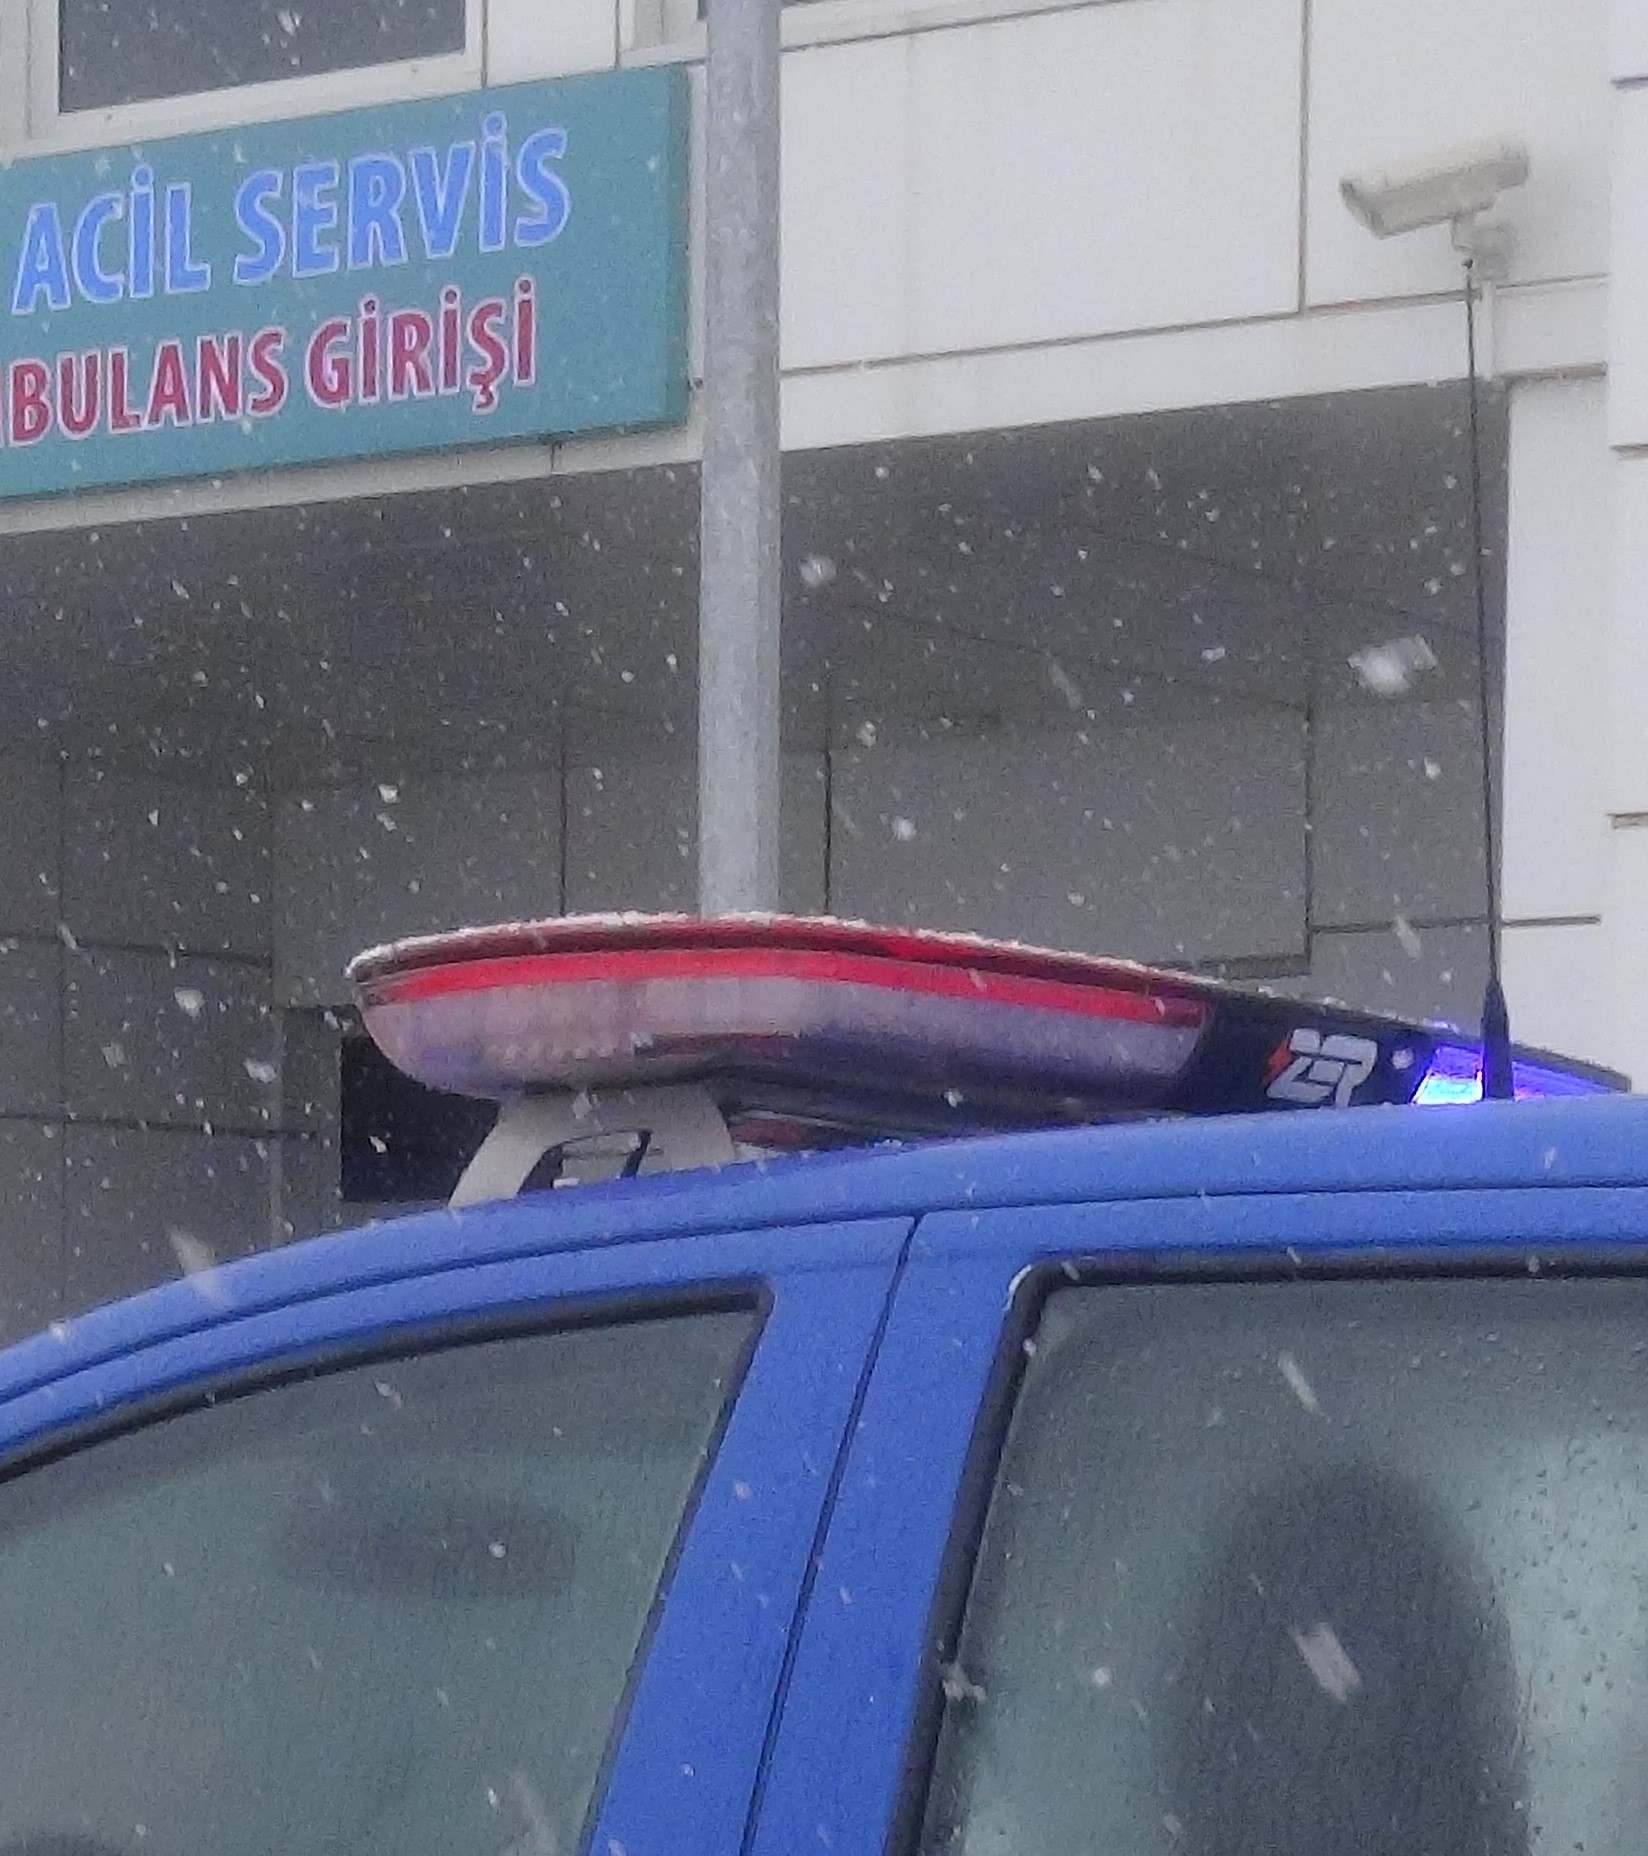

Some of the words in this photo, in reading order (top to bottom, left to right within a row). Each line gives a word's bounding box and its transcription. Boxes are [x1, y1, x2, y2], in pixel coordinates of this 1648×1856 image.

[11, 164, 211, 315] ACİL
[233, 111, 570, 287] SERVİS
[306, 275, 539, 415] GİRİŞİ
